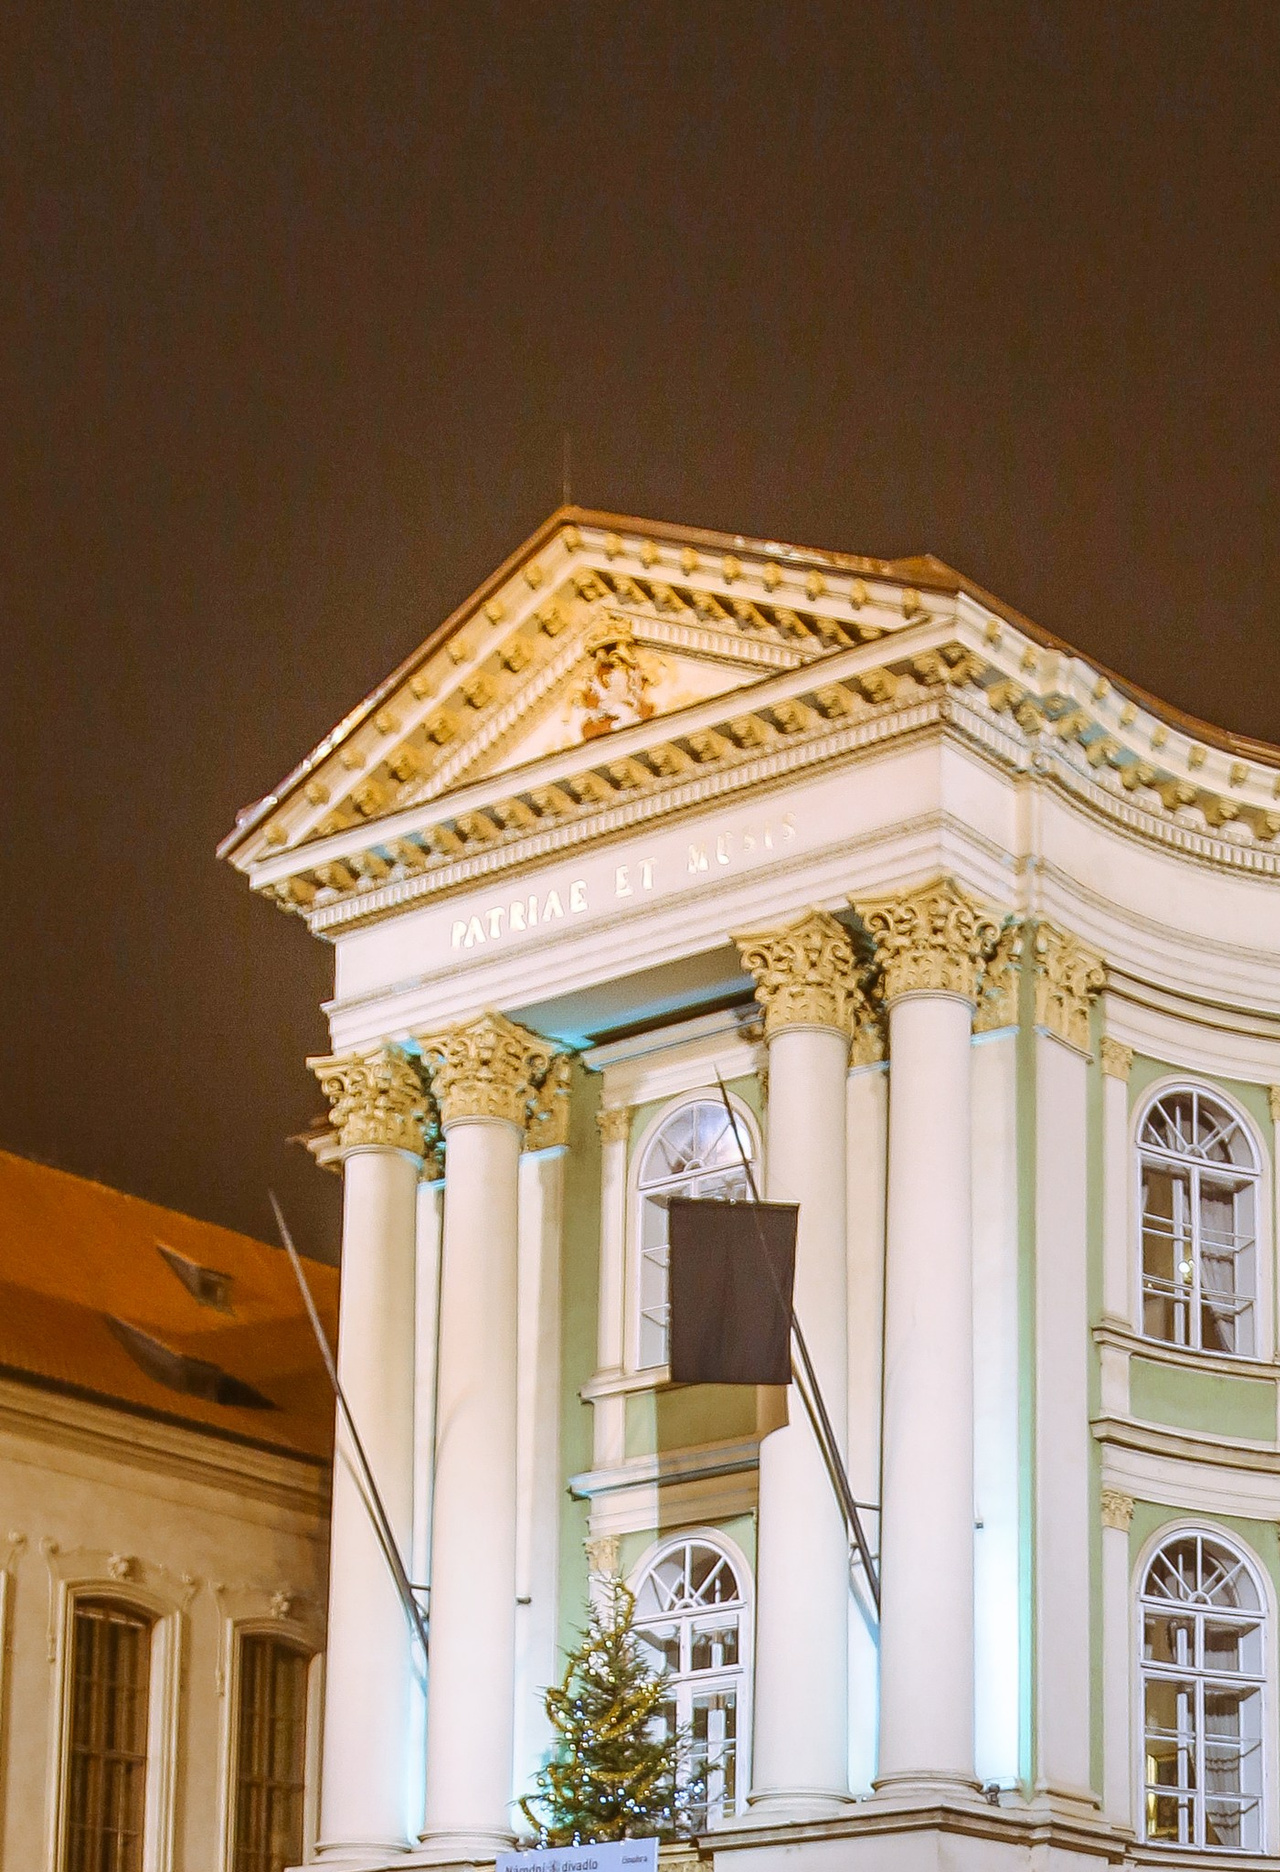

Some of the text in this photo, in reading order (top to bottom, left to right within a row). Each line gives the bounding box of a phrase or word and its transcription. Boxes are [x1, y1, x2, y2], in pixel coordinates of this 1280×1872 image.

[451, 880, 588, 950] PATRIAE
[615, 856, 657, 898] ET
[562, 1859, 598, 1872] divadlo
